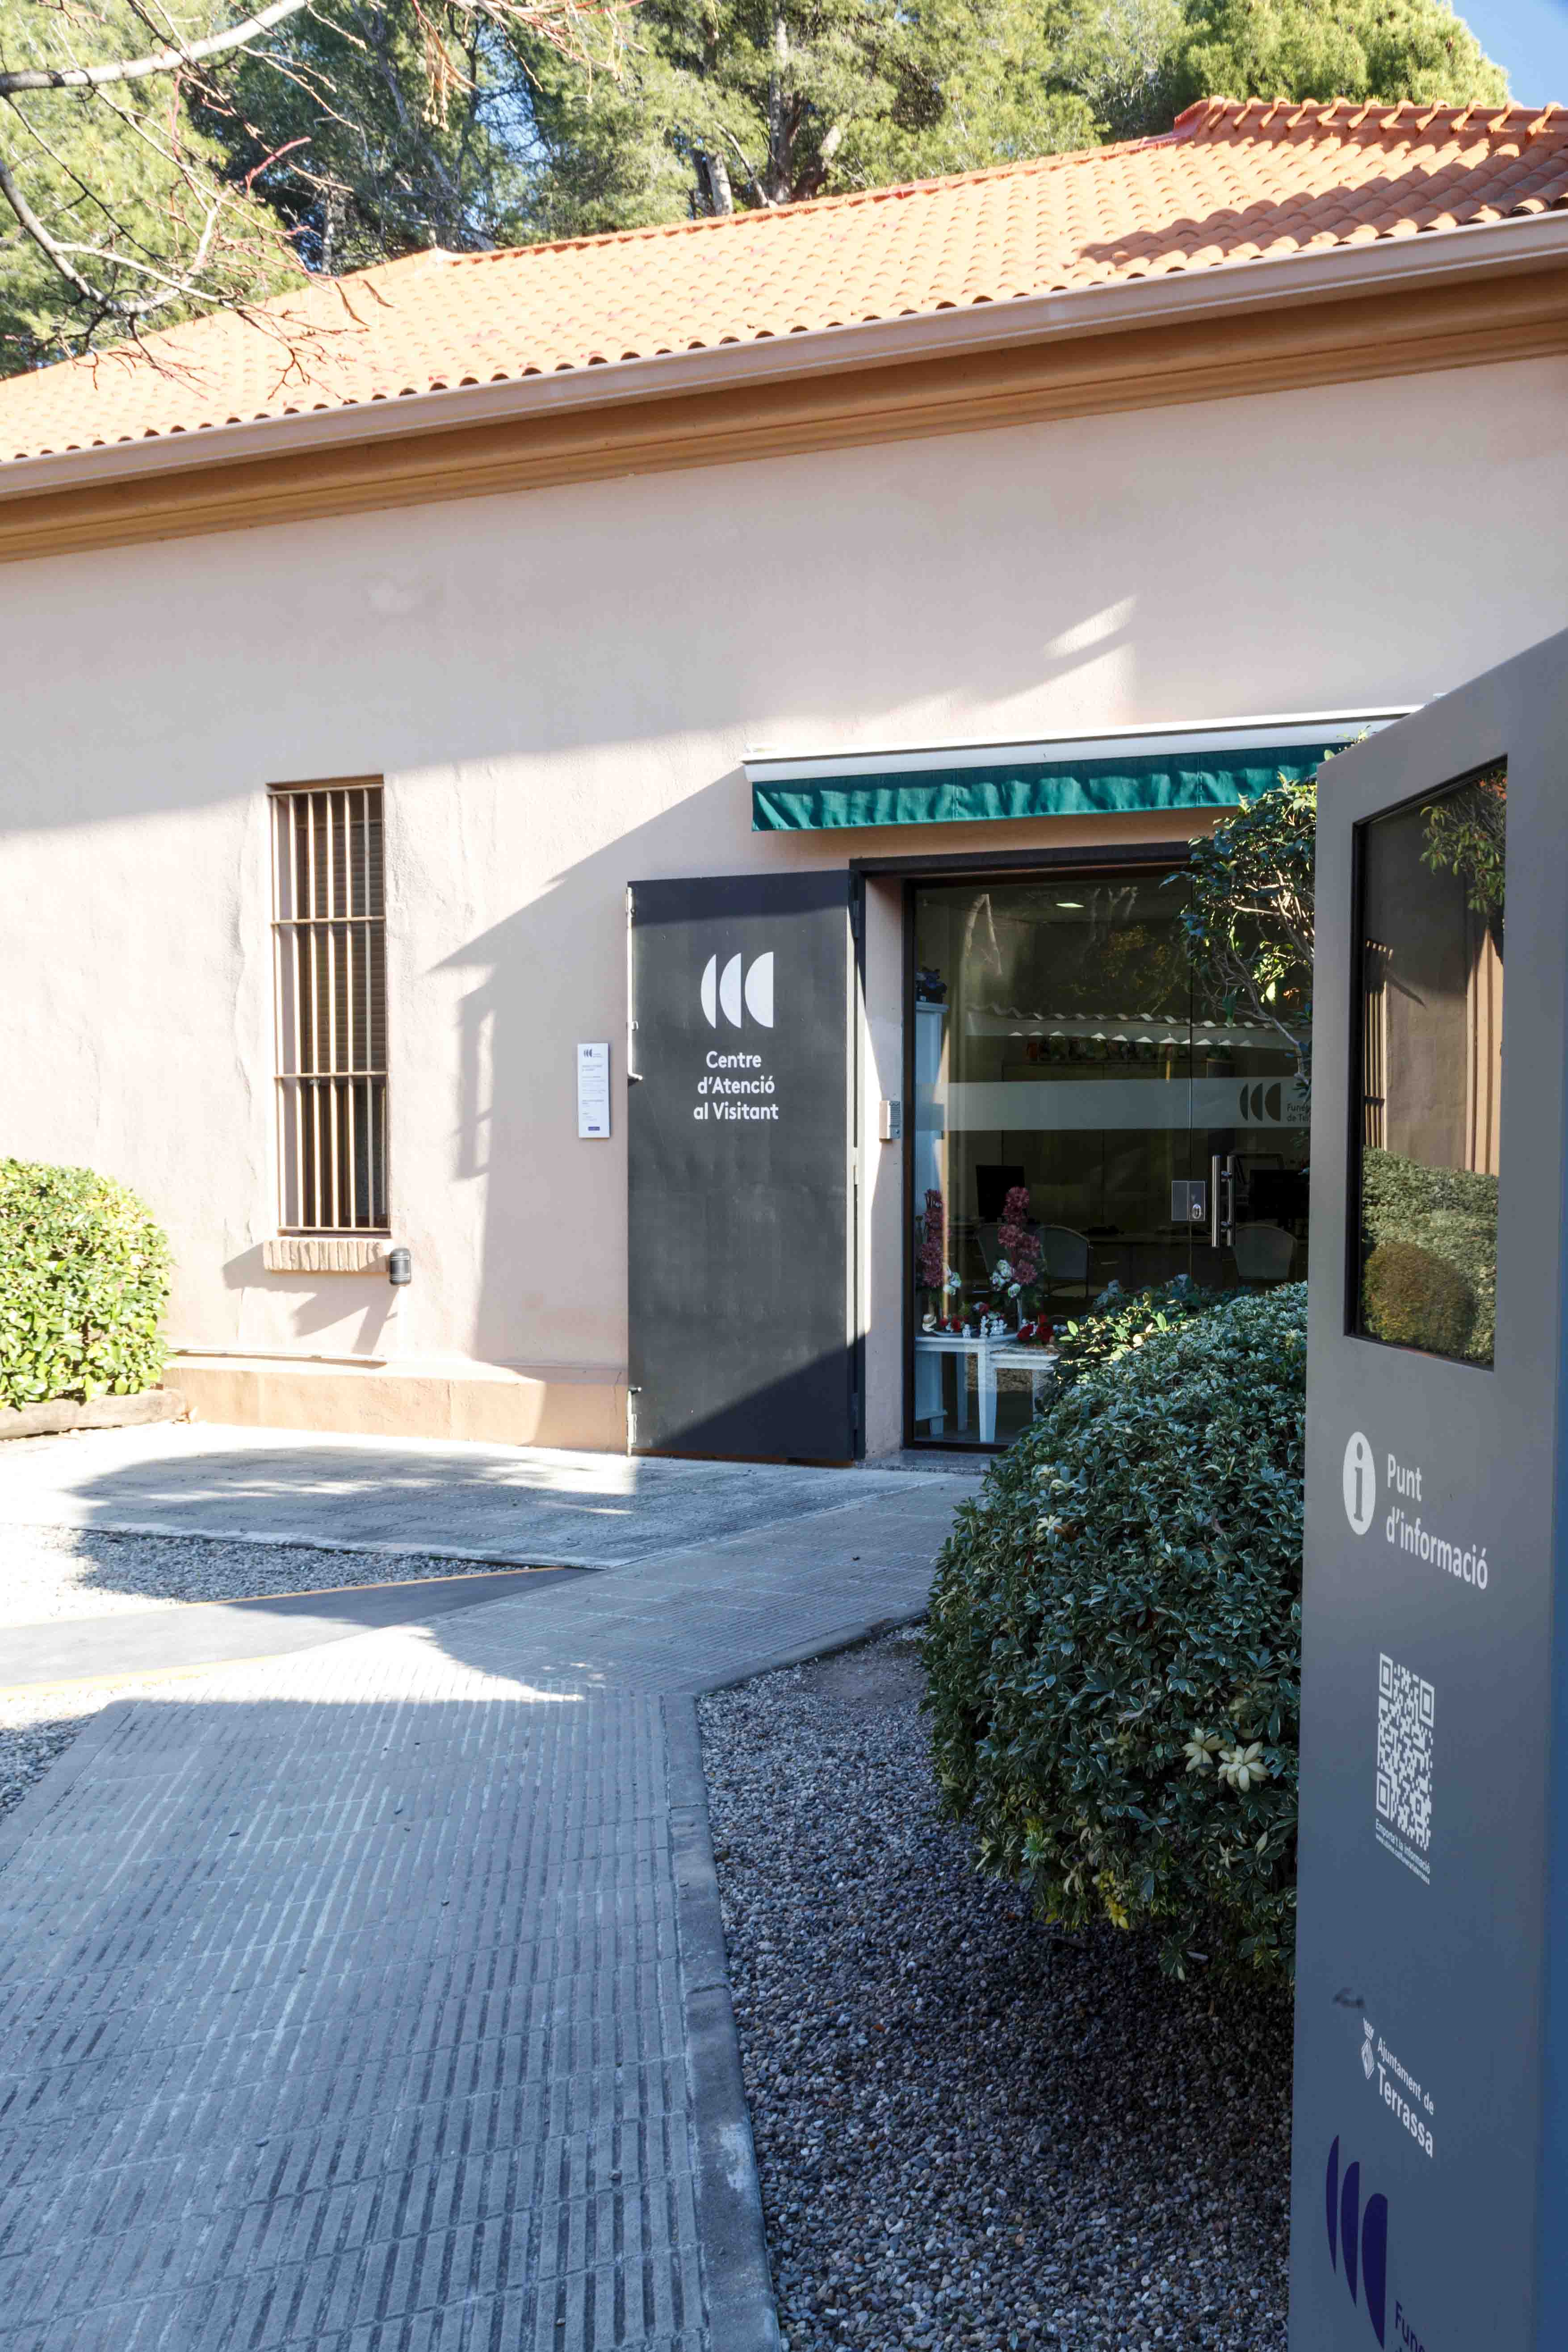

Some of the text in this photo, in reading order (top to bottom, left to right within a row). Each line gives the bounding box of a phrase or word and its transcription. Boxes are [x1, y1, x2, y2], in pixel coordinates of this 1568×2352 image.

[706, 1051, 761, 1068] Centre
[697, 1075, 775, 1094] d'Atenció
[693, 1101, 779, 1119] al Visitant
[1388, 1454, 1422, 1501] Punt
[1387, 1506, 1488, 1589] d'informació
[1378, 2037, 1434, 2115] Ajuntament de
[1377, 2062, 1433, 2158] Terrassa
